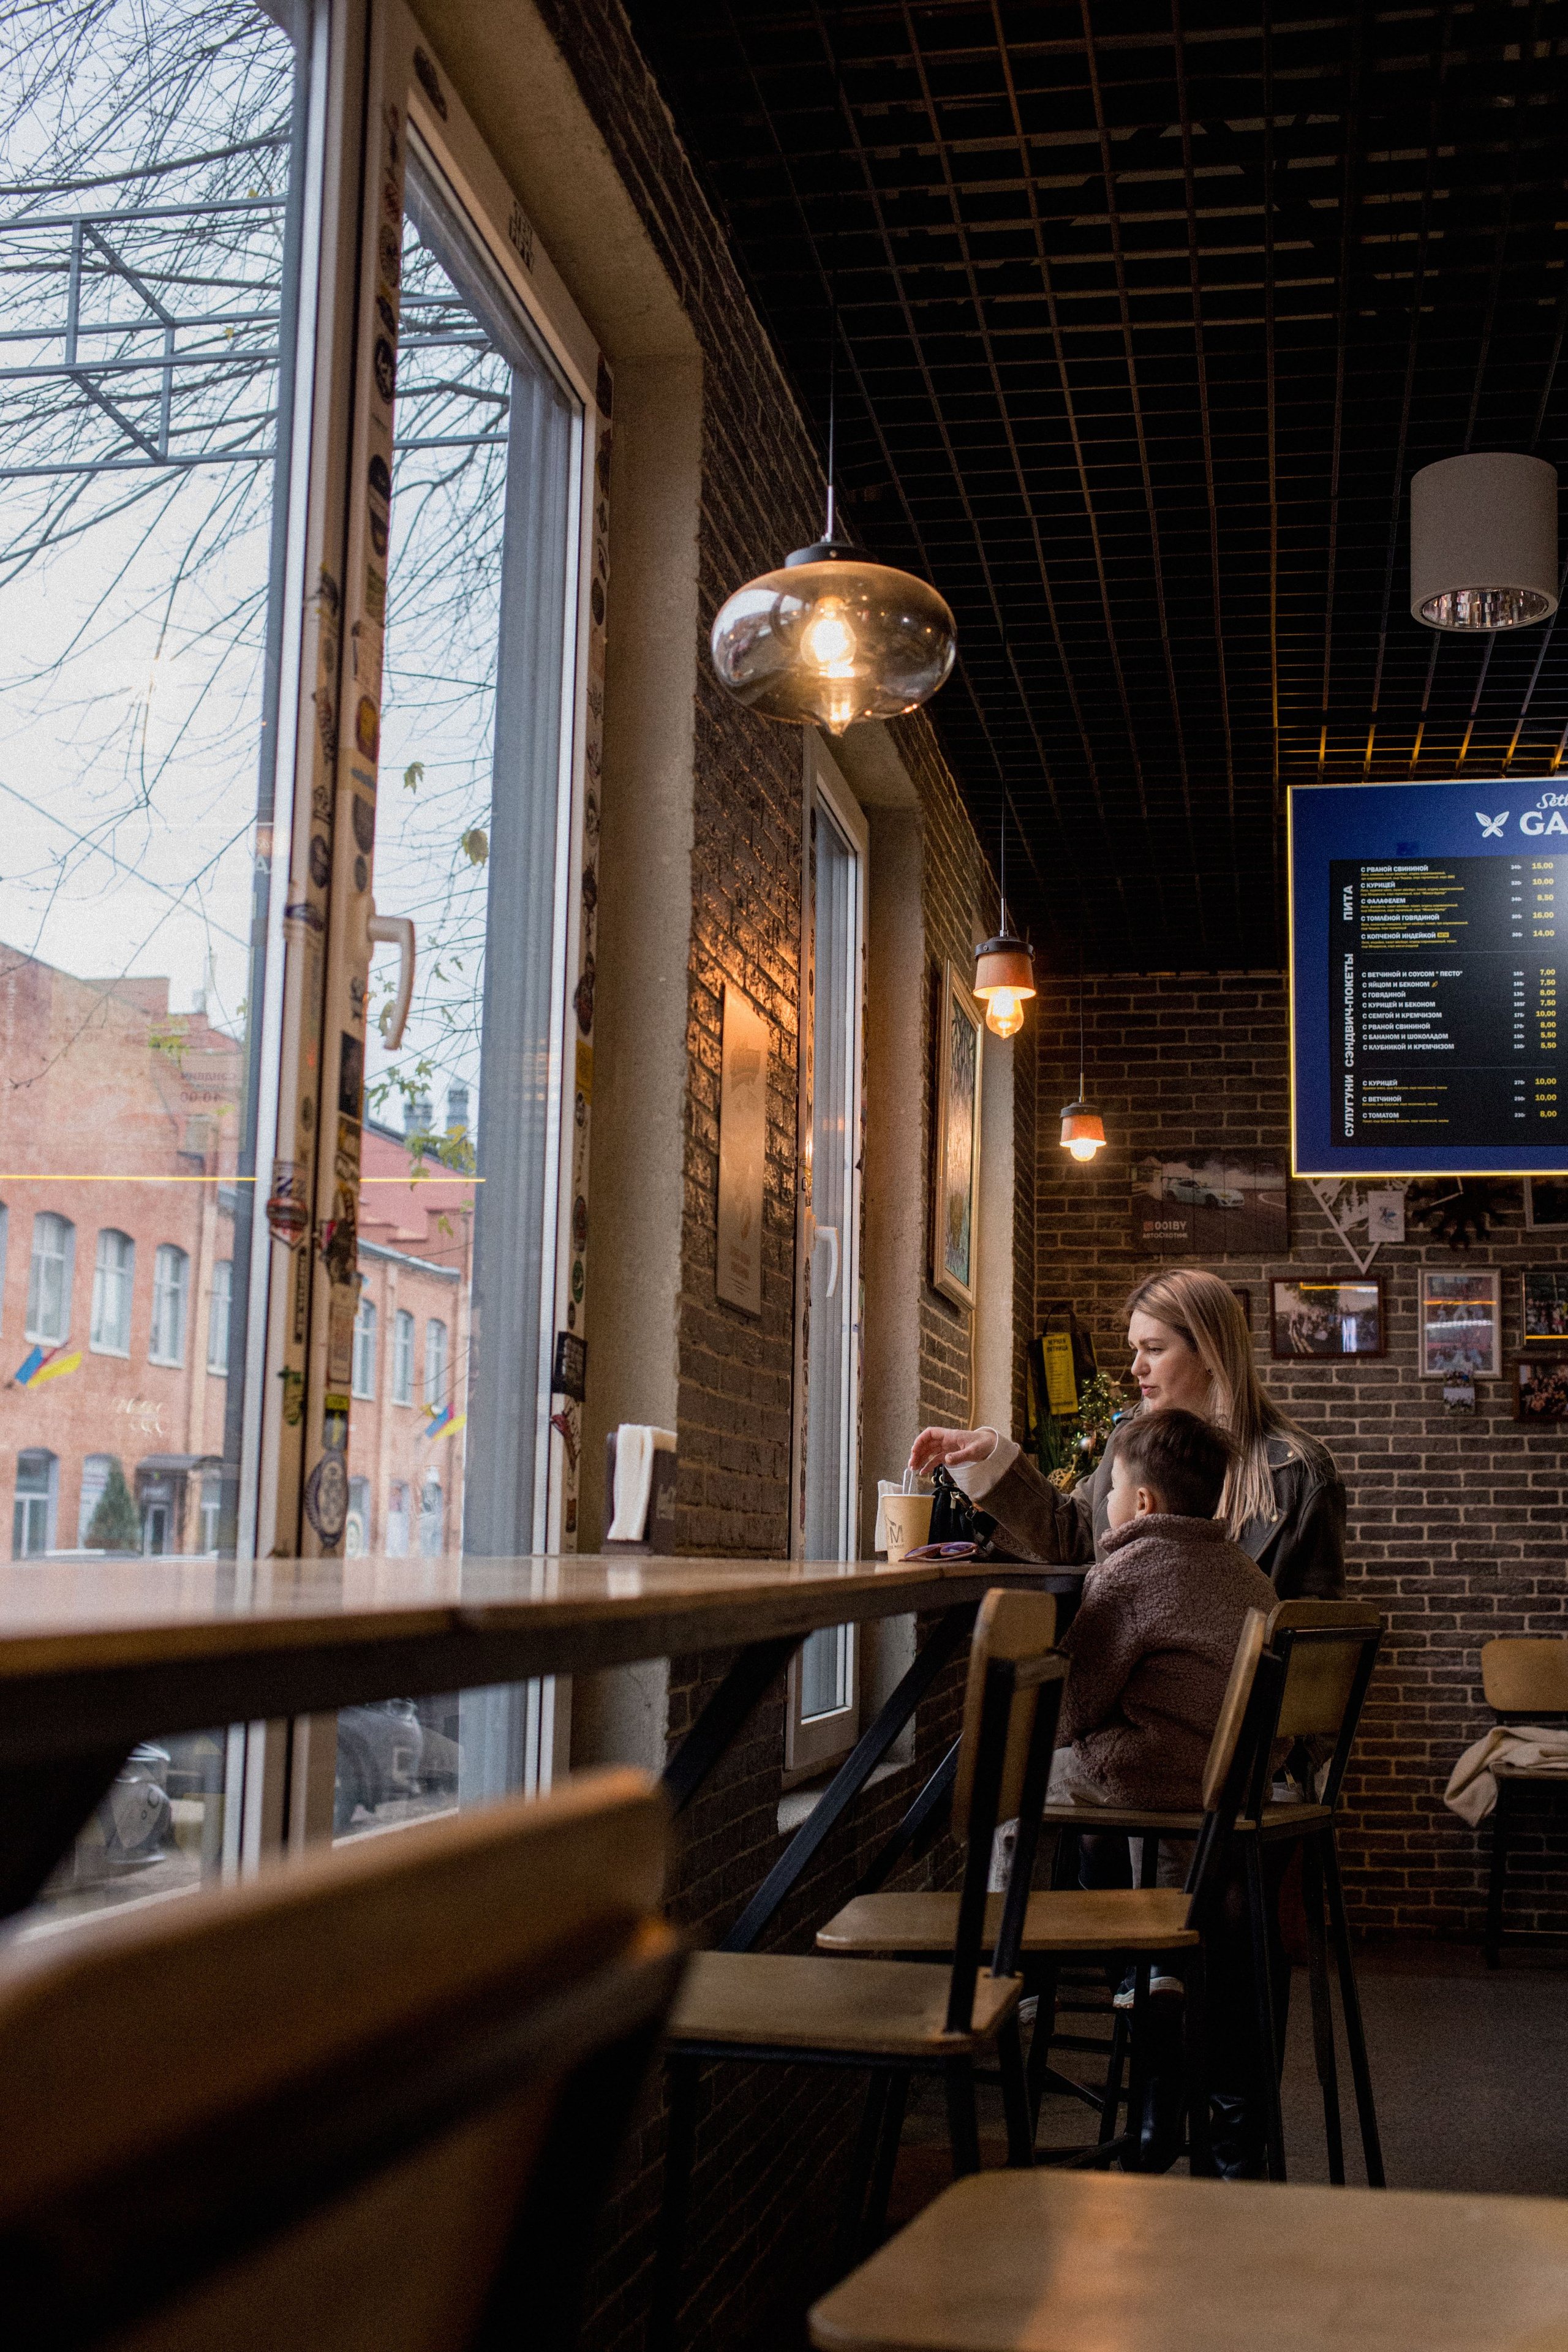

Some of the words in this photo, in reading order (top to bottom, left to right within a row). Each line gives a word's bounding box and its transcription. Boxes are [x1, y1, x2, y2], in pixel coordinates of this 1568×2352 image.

[1343, 885, 1353, 921] ПИТА
[1344, 954, 1355, 1068] СЭНДВИЧ-ПОКЕТЫ
[1344, 1074, 1354, 1137] СУЛУГУНИ
